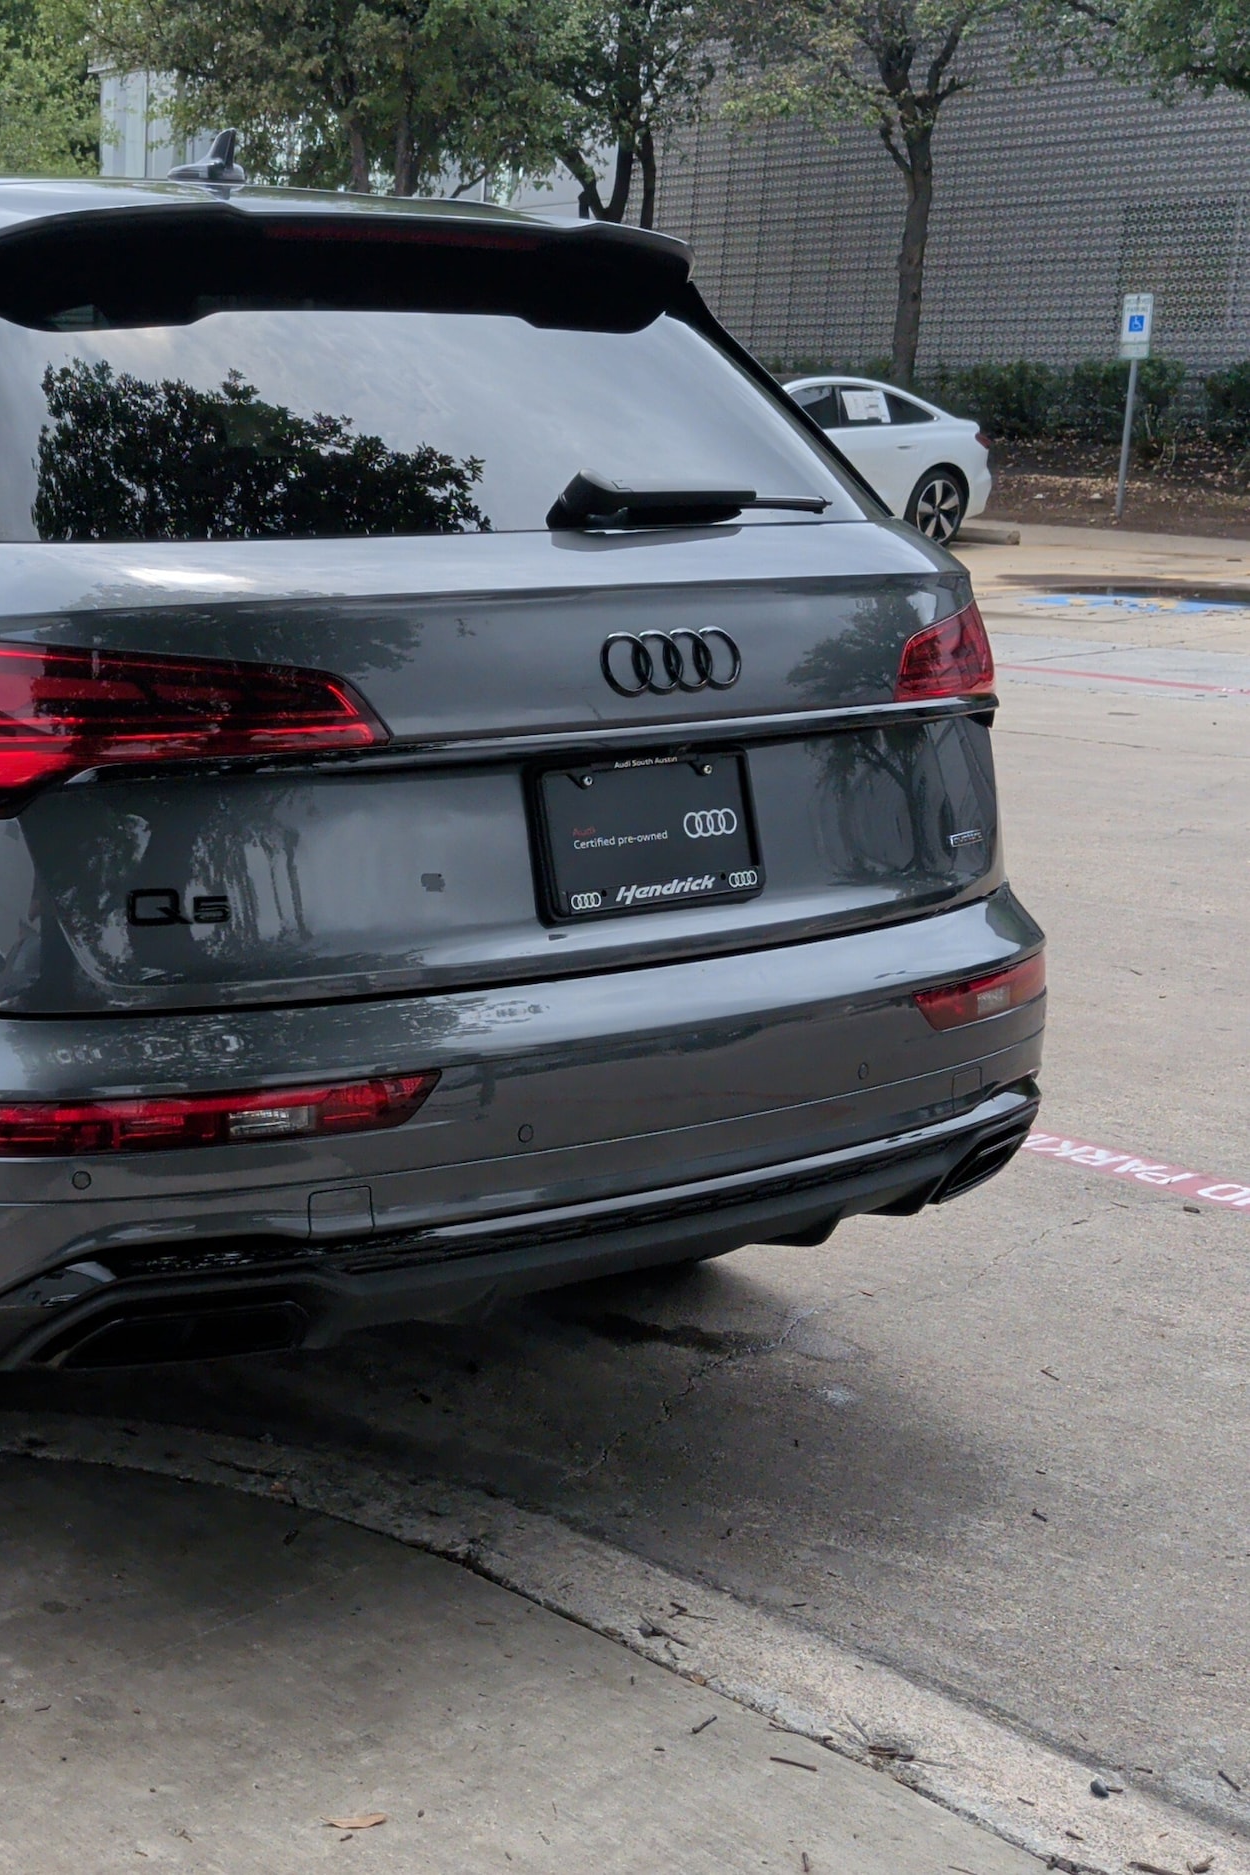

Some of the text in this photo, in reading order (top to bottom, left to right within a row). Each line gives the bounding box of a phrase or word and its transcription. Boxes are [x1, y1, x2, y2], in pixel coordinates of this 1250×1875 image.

[614, 756, 678, 769] Audi South Austin
[573, 826, 596, 837] Audi
[573, 830, 668, 850] Certified pre-owned
[615, 874, 716, 905] Hendrick
[126, 888, 232, 926] Q5
[1197, 1183, 1250, 1207] O
